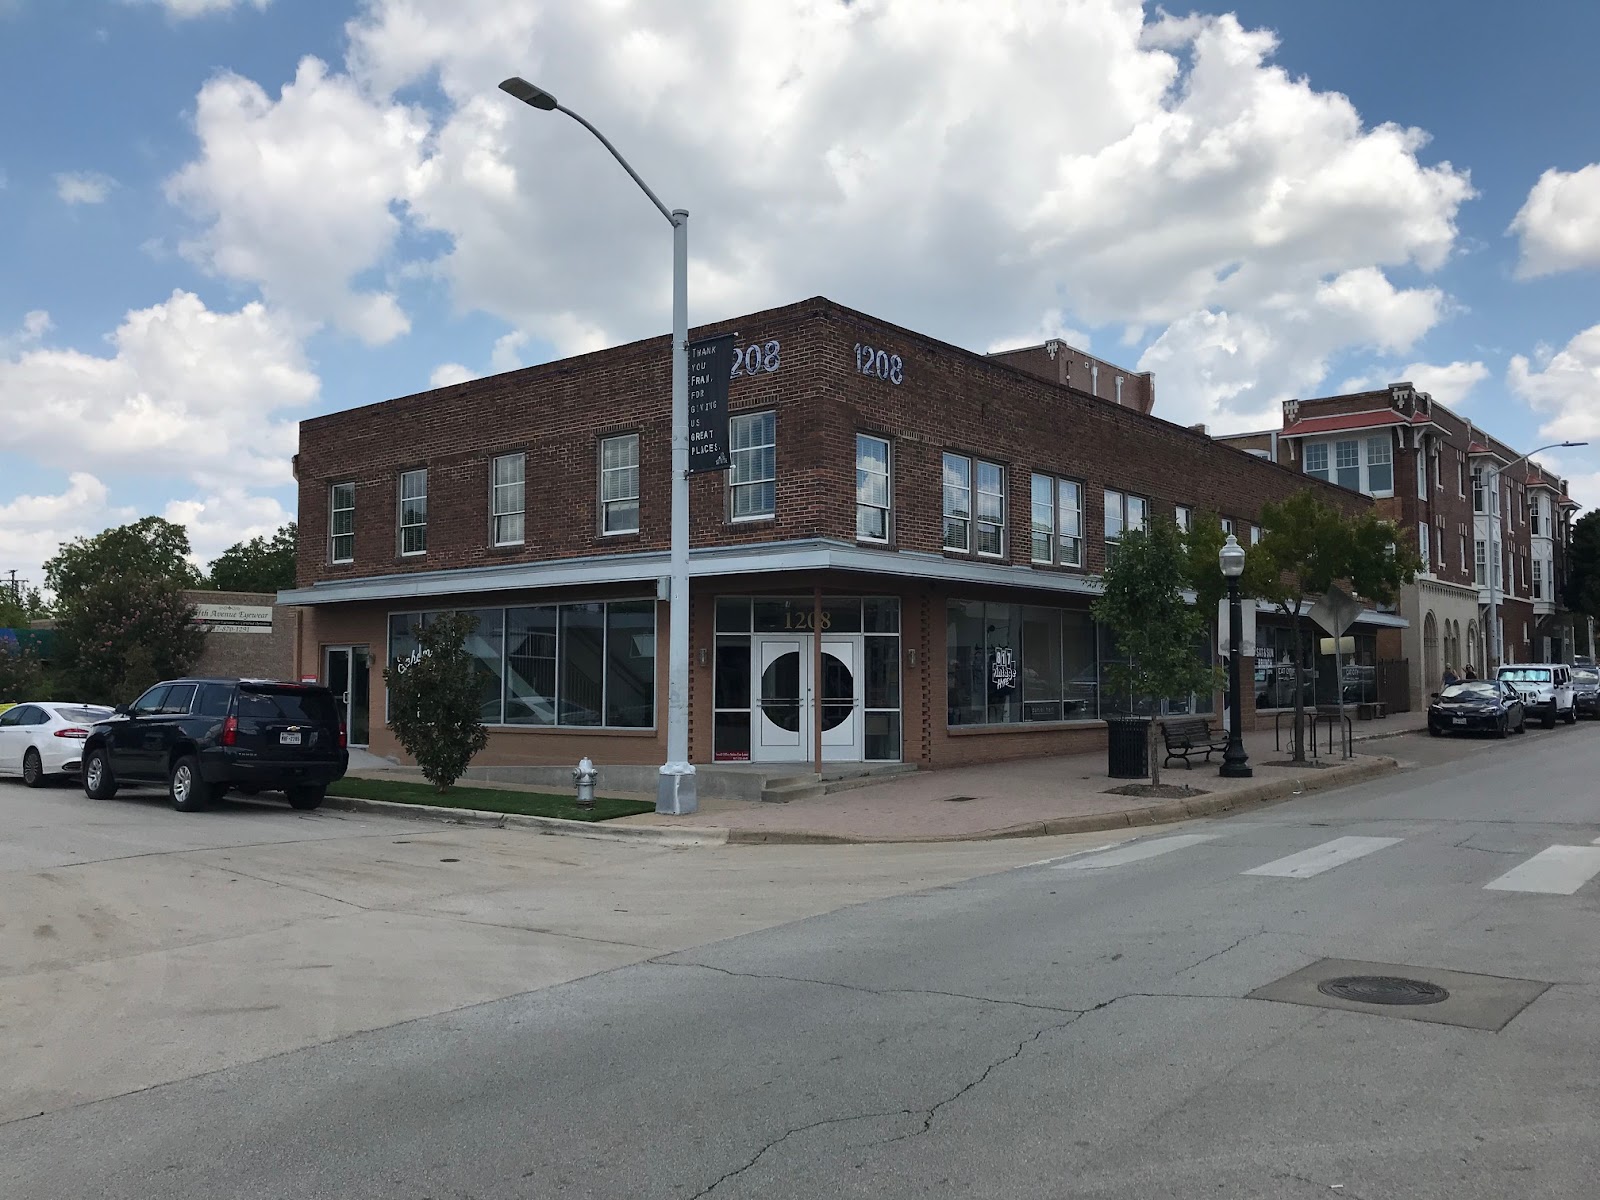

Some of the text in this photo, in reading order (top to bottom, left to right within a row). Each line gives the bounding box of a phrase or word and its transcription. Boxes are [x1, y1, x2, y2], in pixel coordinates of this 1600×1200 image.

[692, 345, 716, 357] THANK
[729, 340, 781, 380] 208
[854, 342, 904, 385] 1208
[691, 362, 706, 372] YOU
[691, 389, 705, 400] FOR
[690, 400, 717, 414] GIVING
[690, 418, 700, 427] US
[690, 429, 714, 442] GREAT
[210, 610, 237, 618] Avenue
[239, 611, 268, 620] Eyewear
[784, 611, 831, 630] 1208
[995, 651, 1011, 665] 817
